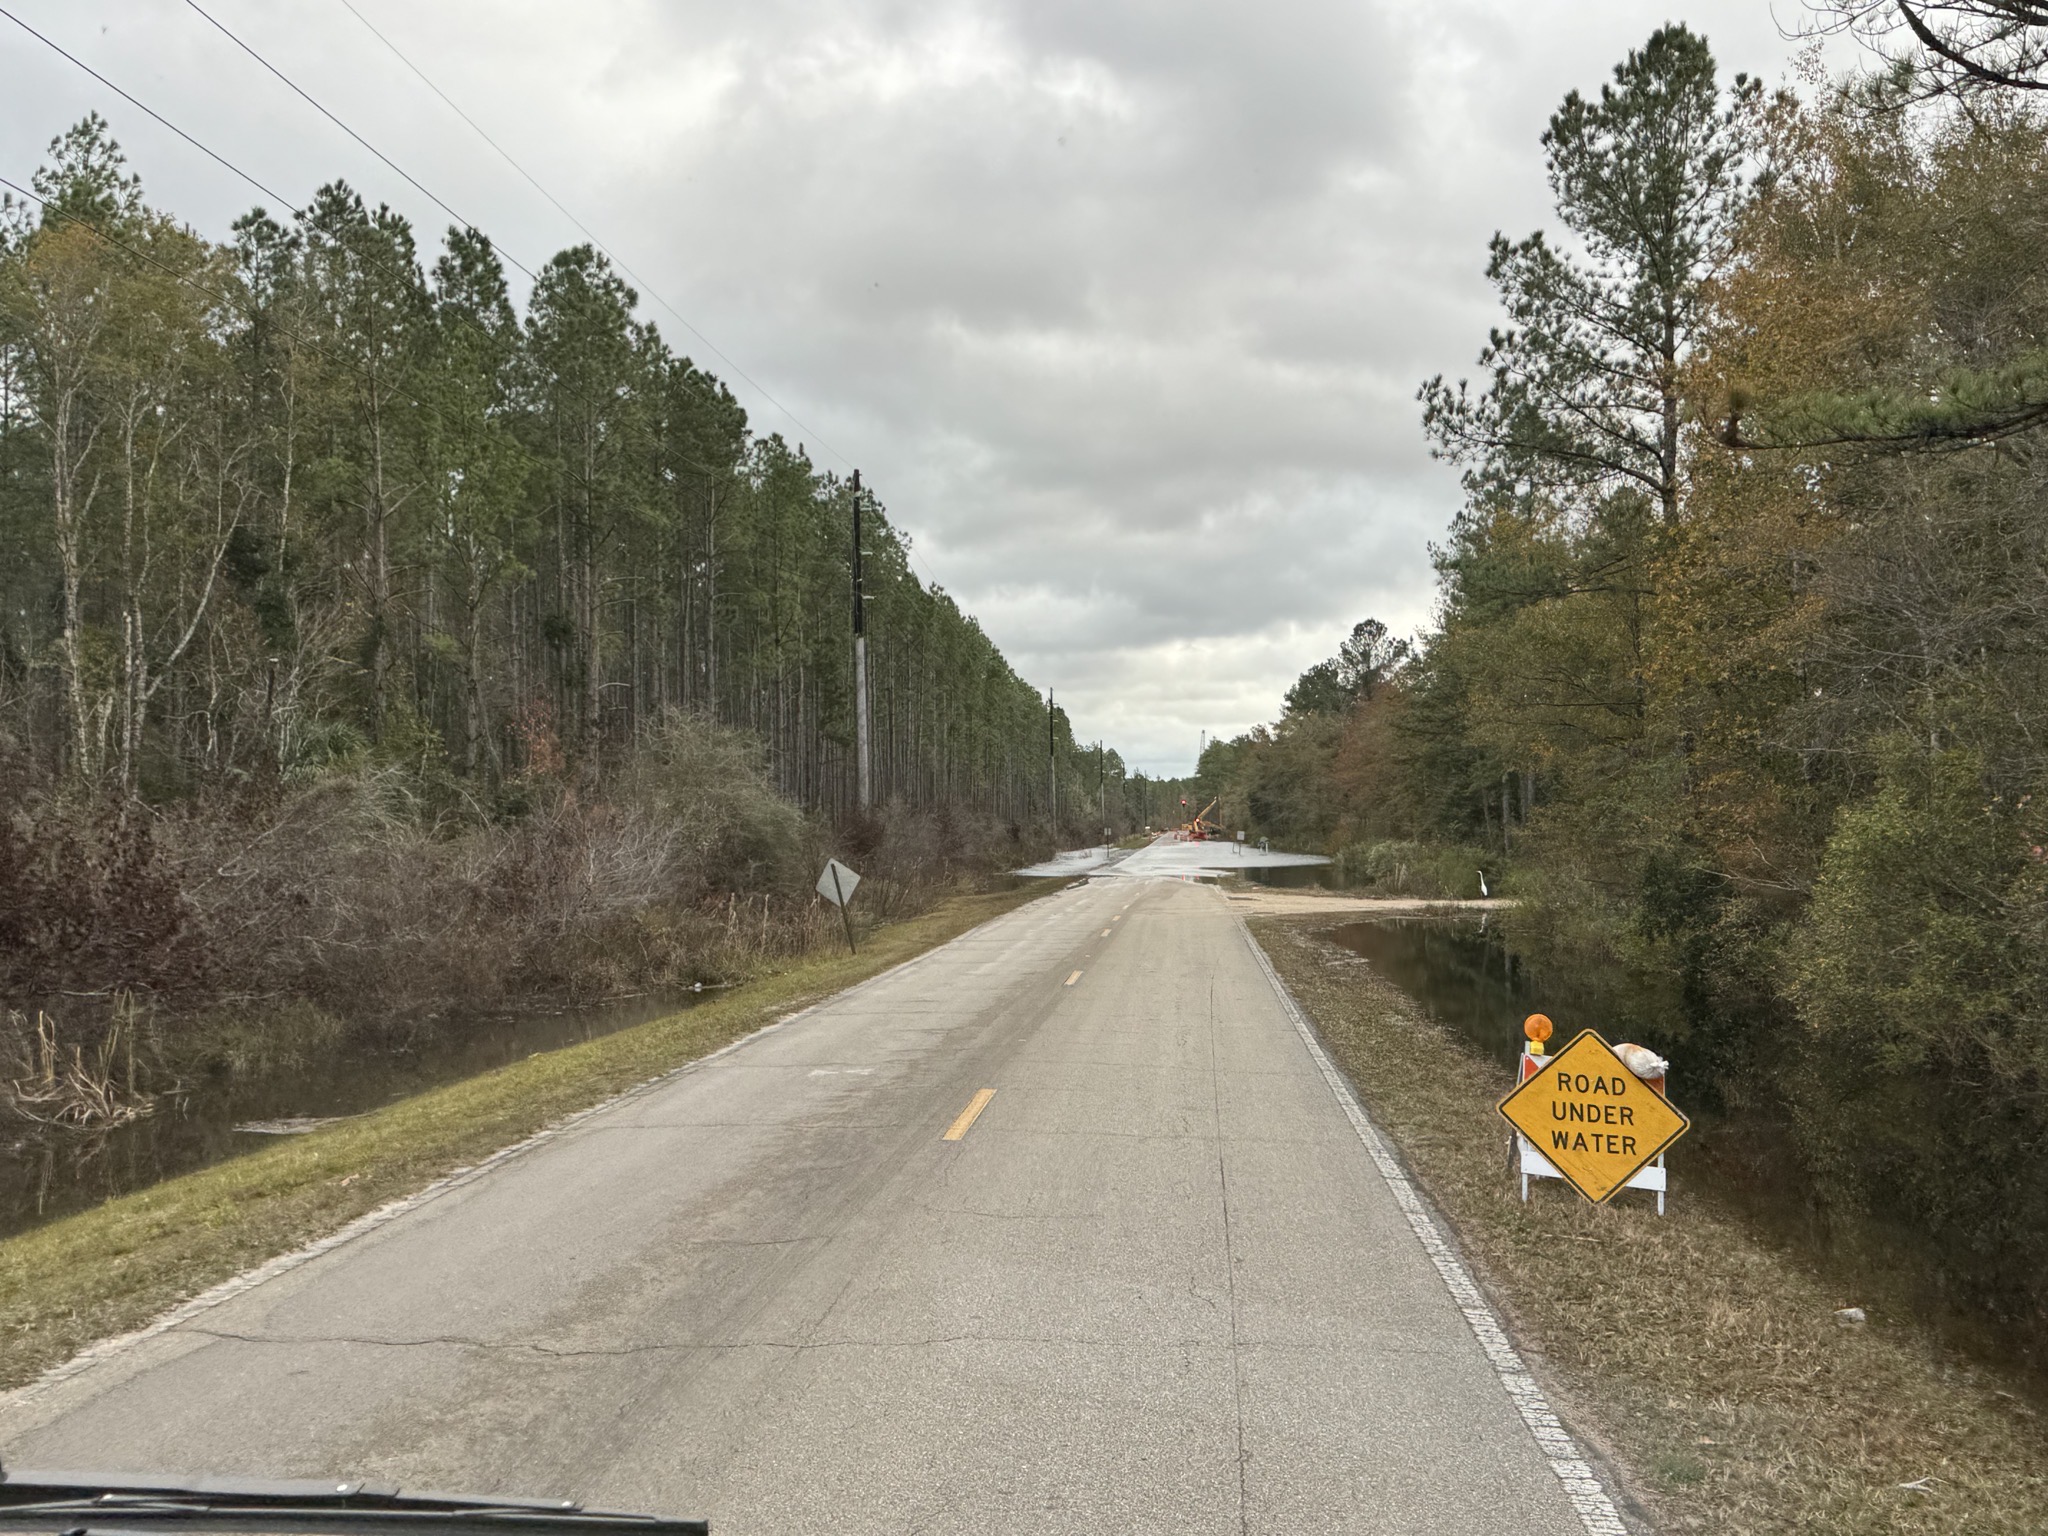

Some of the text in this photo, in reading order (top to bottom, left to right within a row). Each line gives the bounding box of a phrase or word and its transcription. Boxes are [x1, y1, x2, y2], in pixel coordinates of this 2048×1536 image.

[1557, 1072, 1626, 1096] ROAD
[1552, 1100, 1635, 1126] UNDER
[1551, 1130, 1637, 1156] WATER
